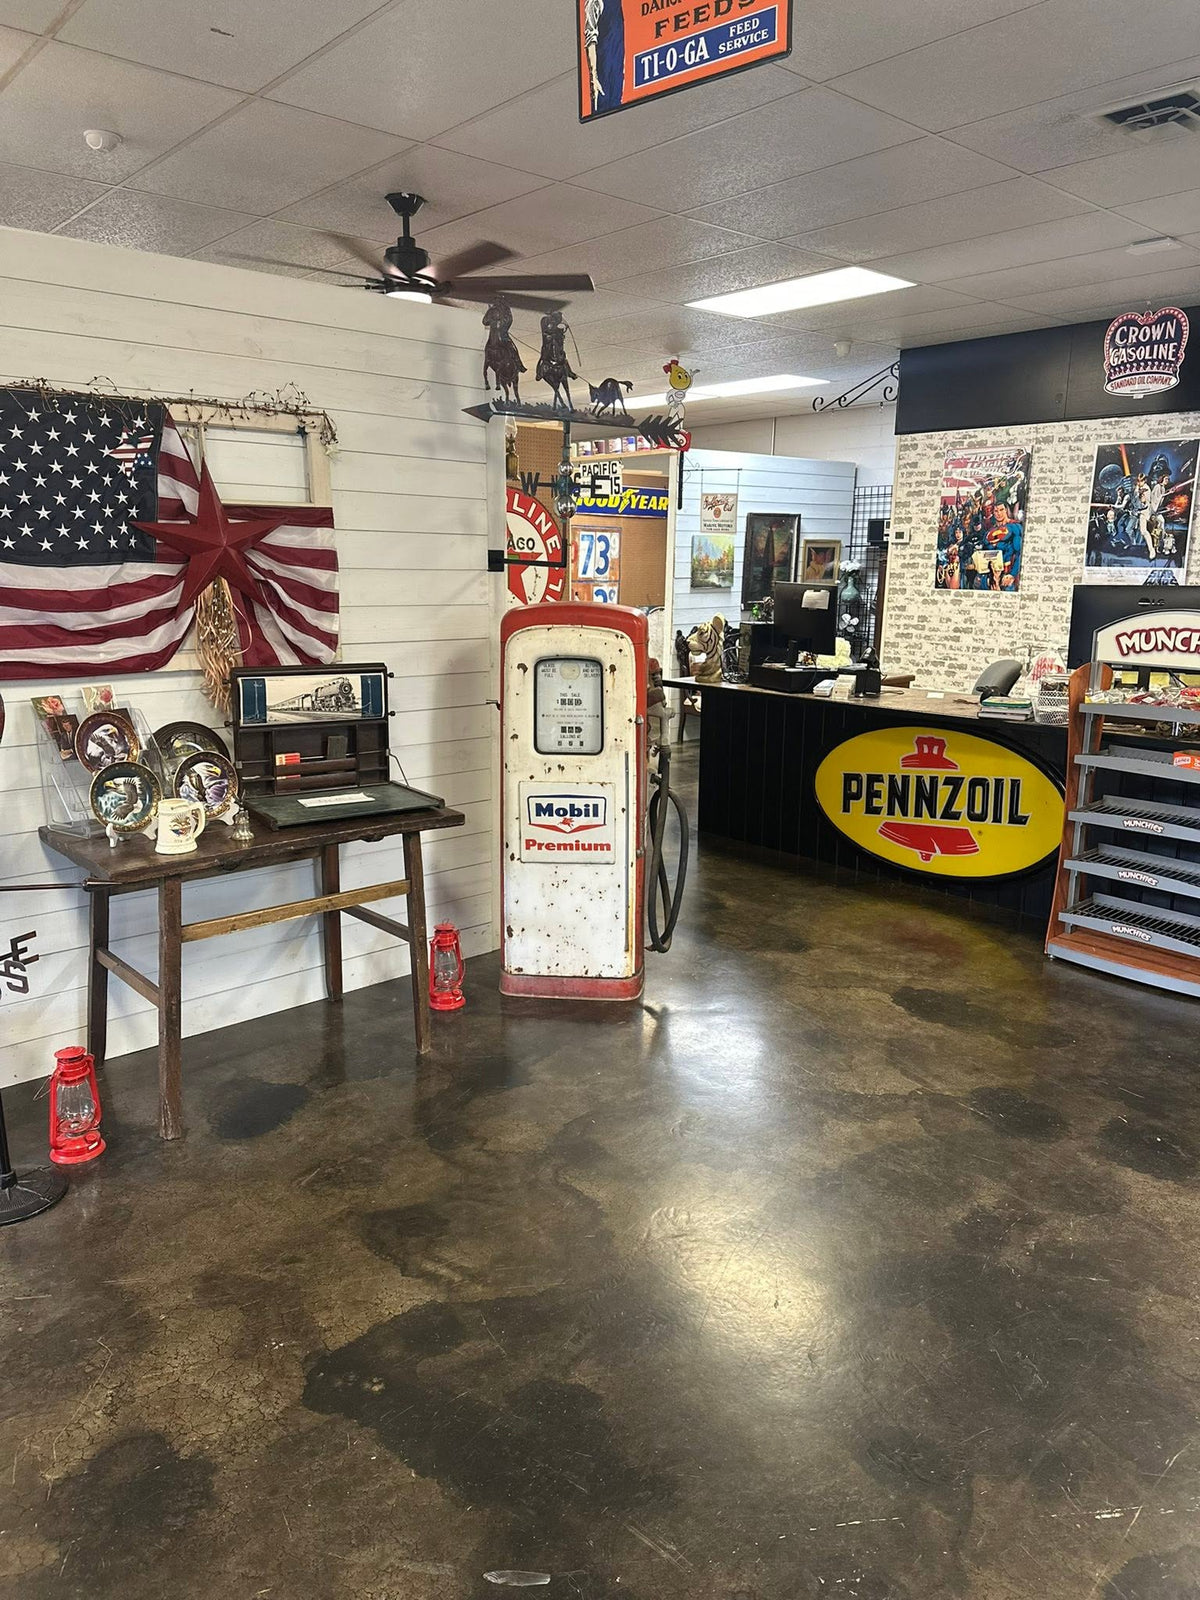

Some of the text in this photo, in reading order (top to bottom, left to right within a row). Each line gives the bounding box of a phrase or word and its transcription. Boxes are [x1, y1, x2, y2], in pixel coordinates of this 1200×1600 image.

[654, 0, 755, 39] FEEDS
[729, 17, 760, 37] FEED
[641, 28, 770, 80] TI-O-GA SERVICE
[1115, 319, 1177, 345] CROWN
[1110, 342, 1178, 366] GASOLINE
[582, 462, 618, 477] PACIFIC
[841, 772, 1032, 826] PENNZOIL
[535, 803, 599, 818] Mobil
[1123, 820, 1164, 833] MUNCHIES
[525, 839, 611, 852] Premium
[1118, 871, 1159, 886] MUNCHIES
[1111, 926, 1152, 942] MUNCHIES
